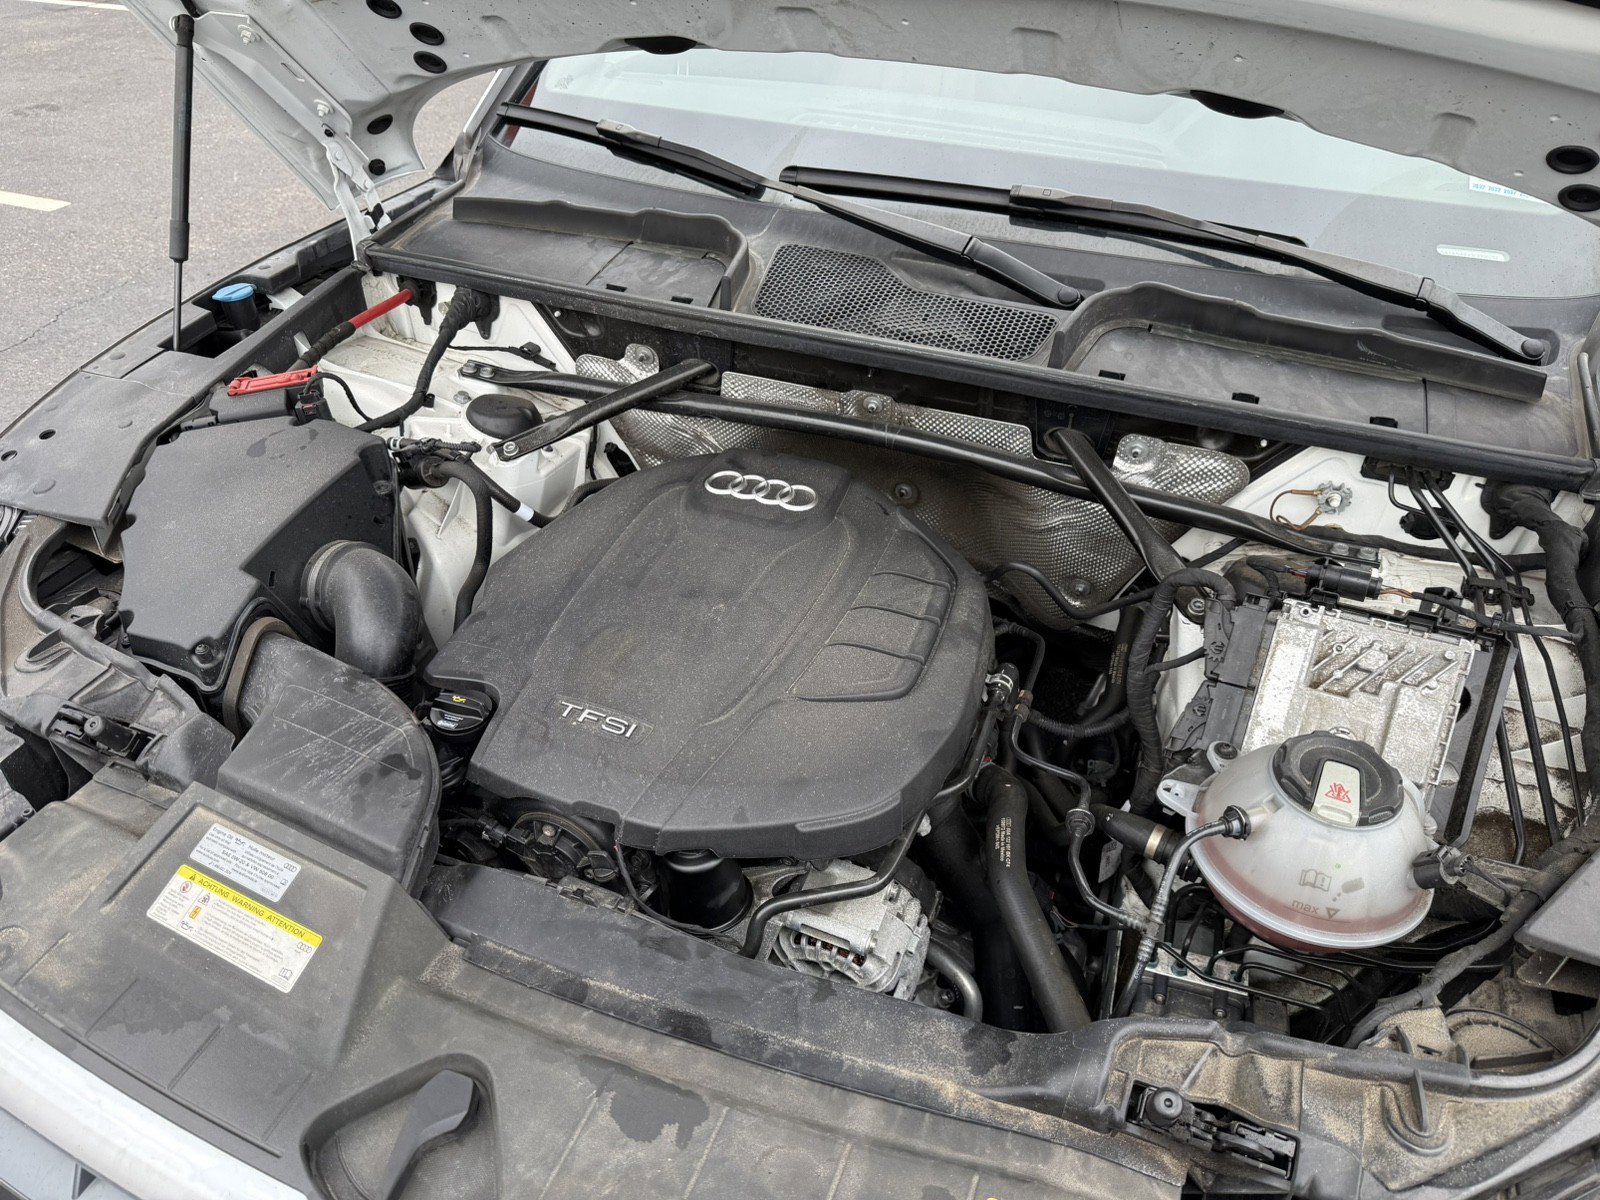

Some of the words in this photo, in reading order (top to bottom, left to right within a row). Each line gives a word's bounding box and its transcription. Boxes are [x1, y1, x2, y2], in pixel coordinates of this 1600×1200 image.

[560, 701, 638, 739] TFSI
[211, 826, 227, 837] Engine
[247, 844, 259, 853] Huile
[220, 849, 231, 857] SAE
[249, 864, 259, 872] VW
[197, 877, 230, 898] ACHTUNG
[230, 895, 265, 917] WARNING
[265, 913, 305, 938] ATTENTION
[1291, 899, 1320, 915] max
